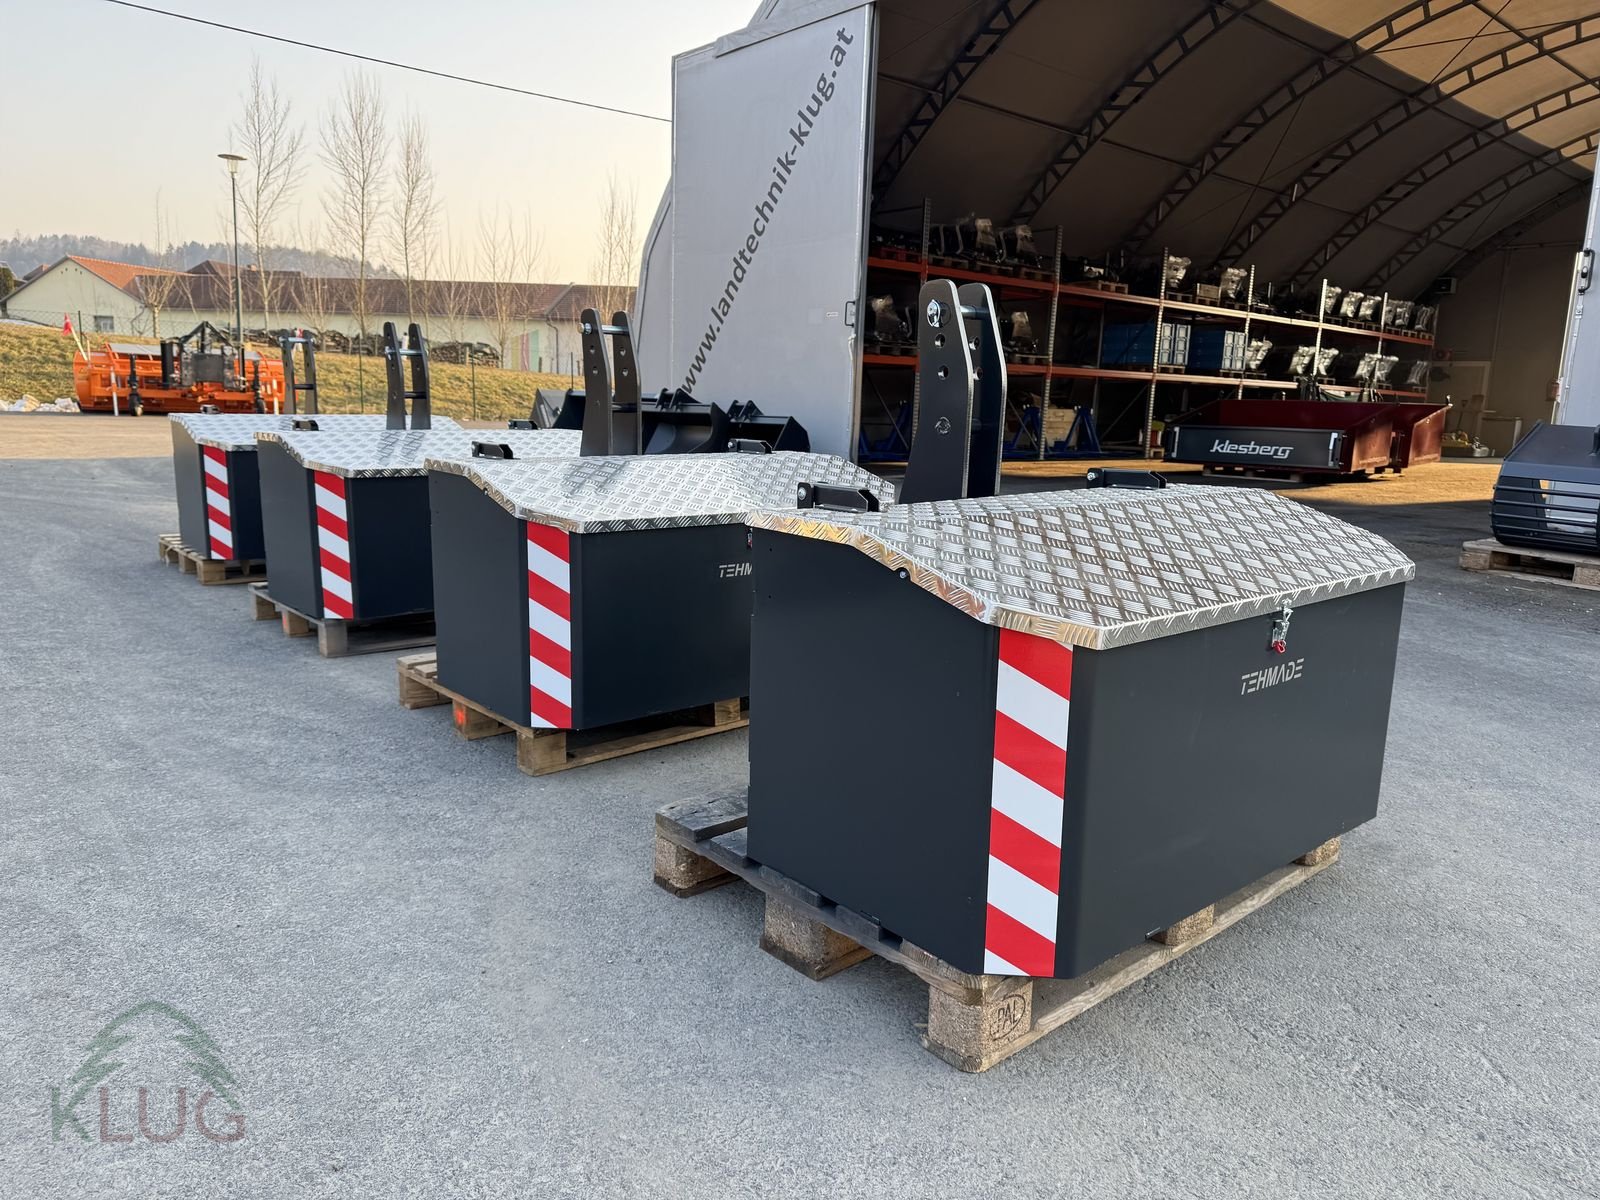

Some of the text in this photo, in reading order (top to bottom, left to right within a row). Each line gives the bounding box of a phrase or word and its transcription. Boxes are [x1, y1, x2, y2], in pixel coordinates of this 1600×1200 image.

[682, 26, 854, 395] www.landtechnik-klug.at
[1210, 439, 1293, 459] klesberg
[1241, 658, 1304, 695] TEHMADE
